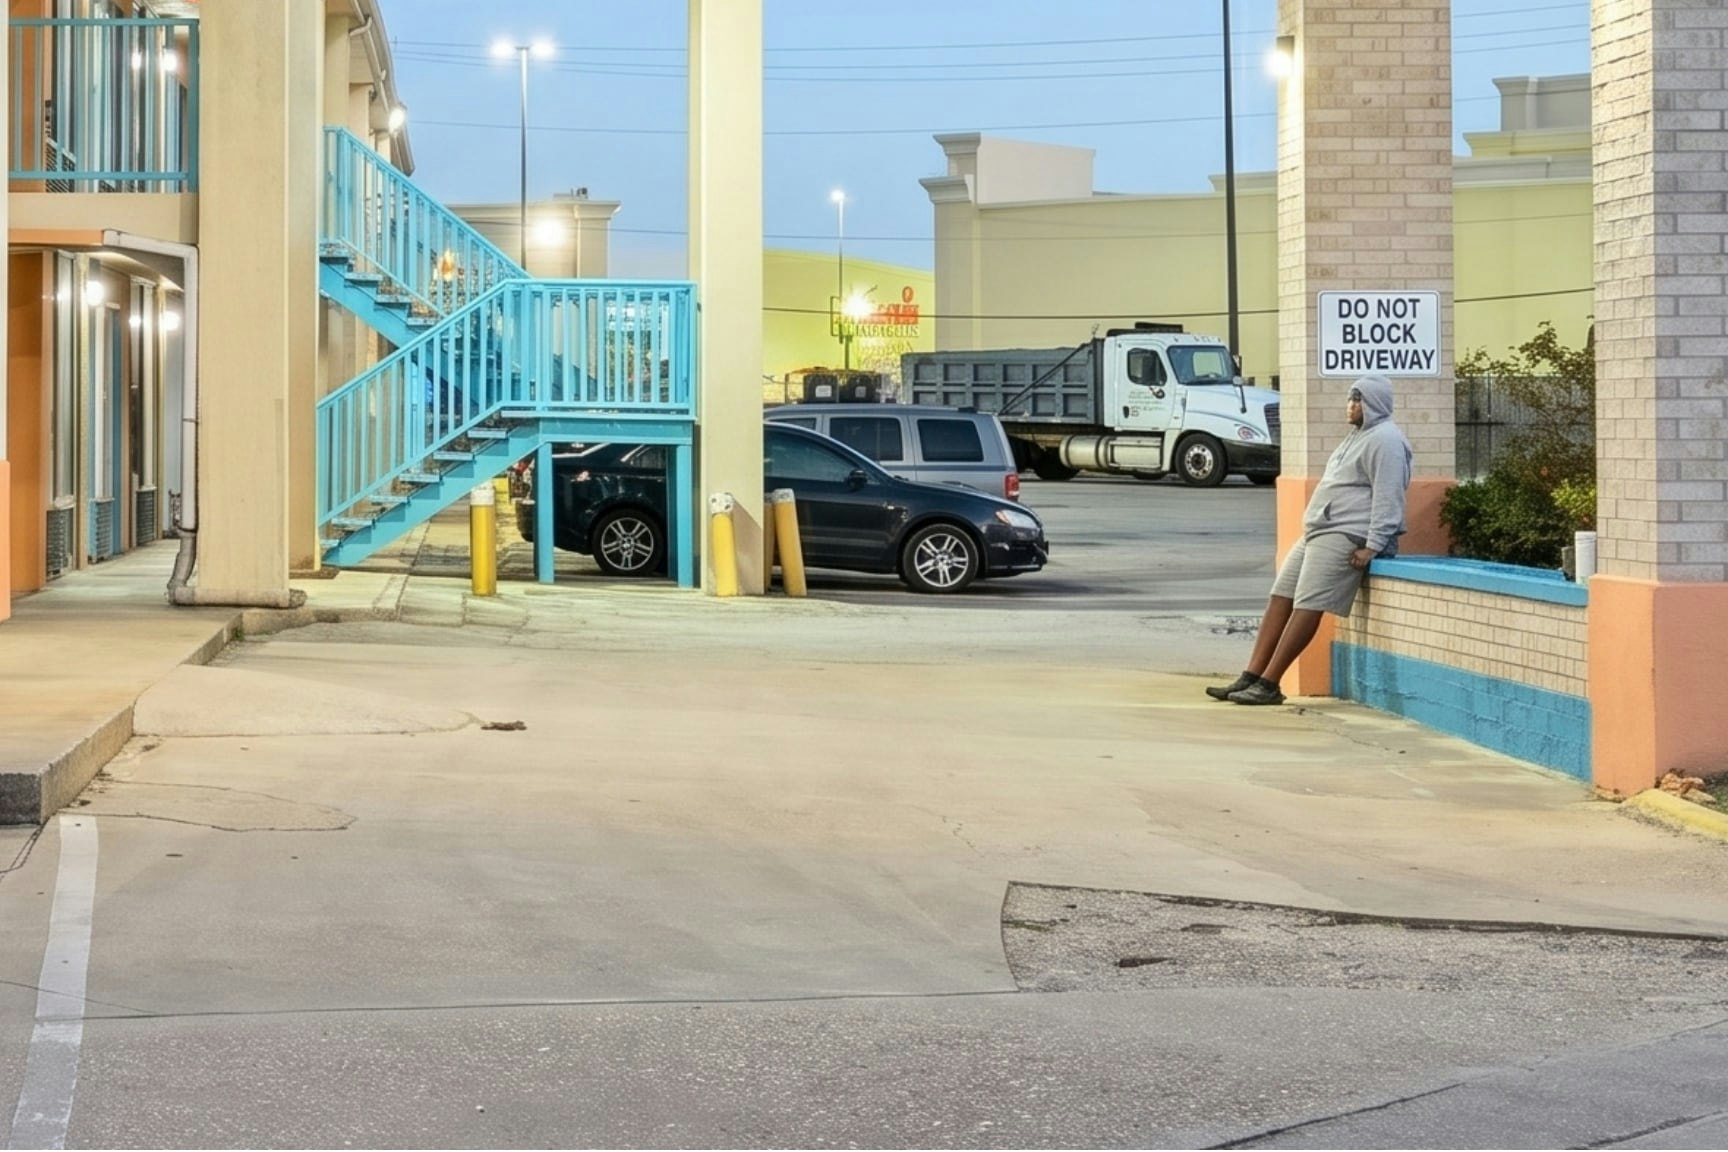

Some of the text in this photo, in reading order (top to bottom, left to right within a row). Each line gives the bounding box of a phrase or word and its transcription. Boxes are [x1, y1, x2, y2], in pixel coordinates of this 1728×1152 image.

[1338, 298, 1421, 319] DO NOT
[1342, 323, 1416, 344] BLOCK
[1325, 349, 1435, 370] DRIVEWAY
